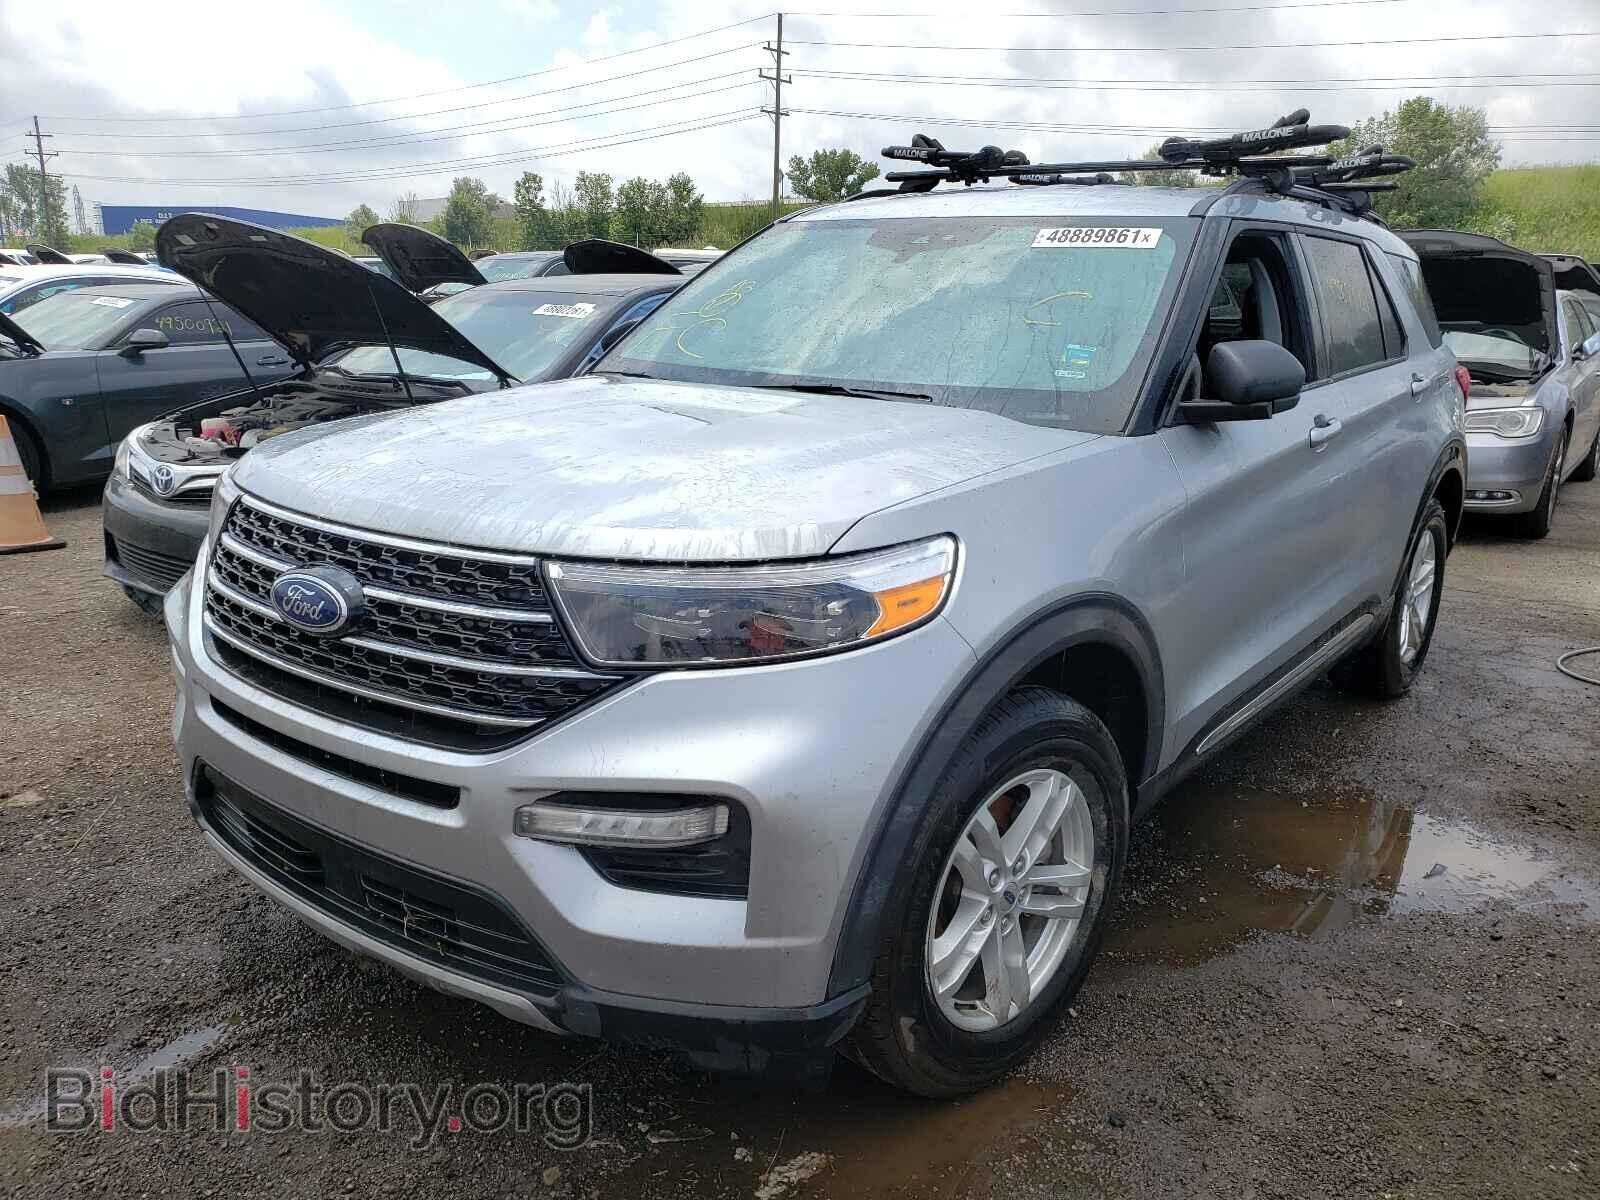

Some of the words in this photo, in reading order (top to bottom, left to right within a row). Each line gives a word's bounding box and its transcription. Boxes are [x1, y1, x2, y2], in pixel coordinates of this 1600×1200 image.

[1241, 127, 1294, 143] MALONE
[893, 148, 928, 160] MALONE
[1327, 157, 1371, 171] MALONE
[282, 584, 326, 621] Ford
